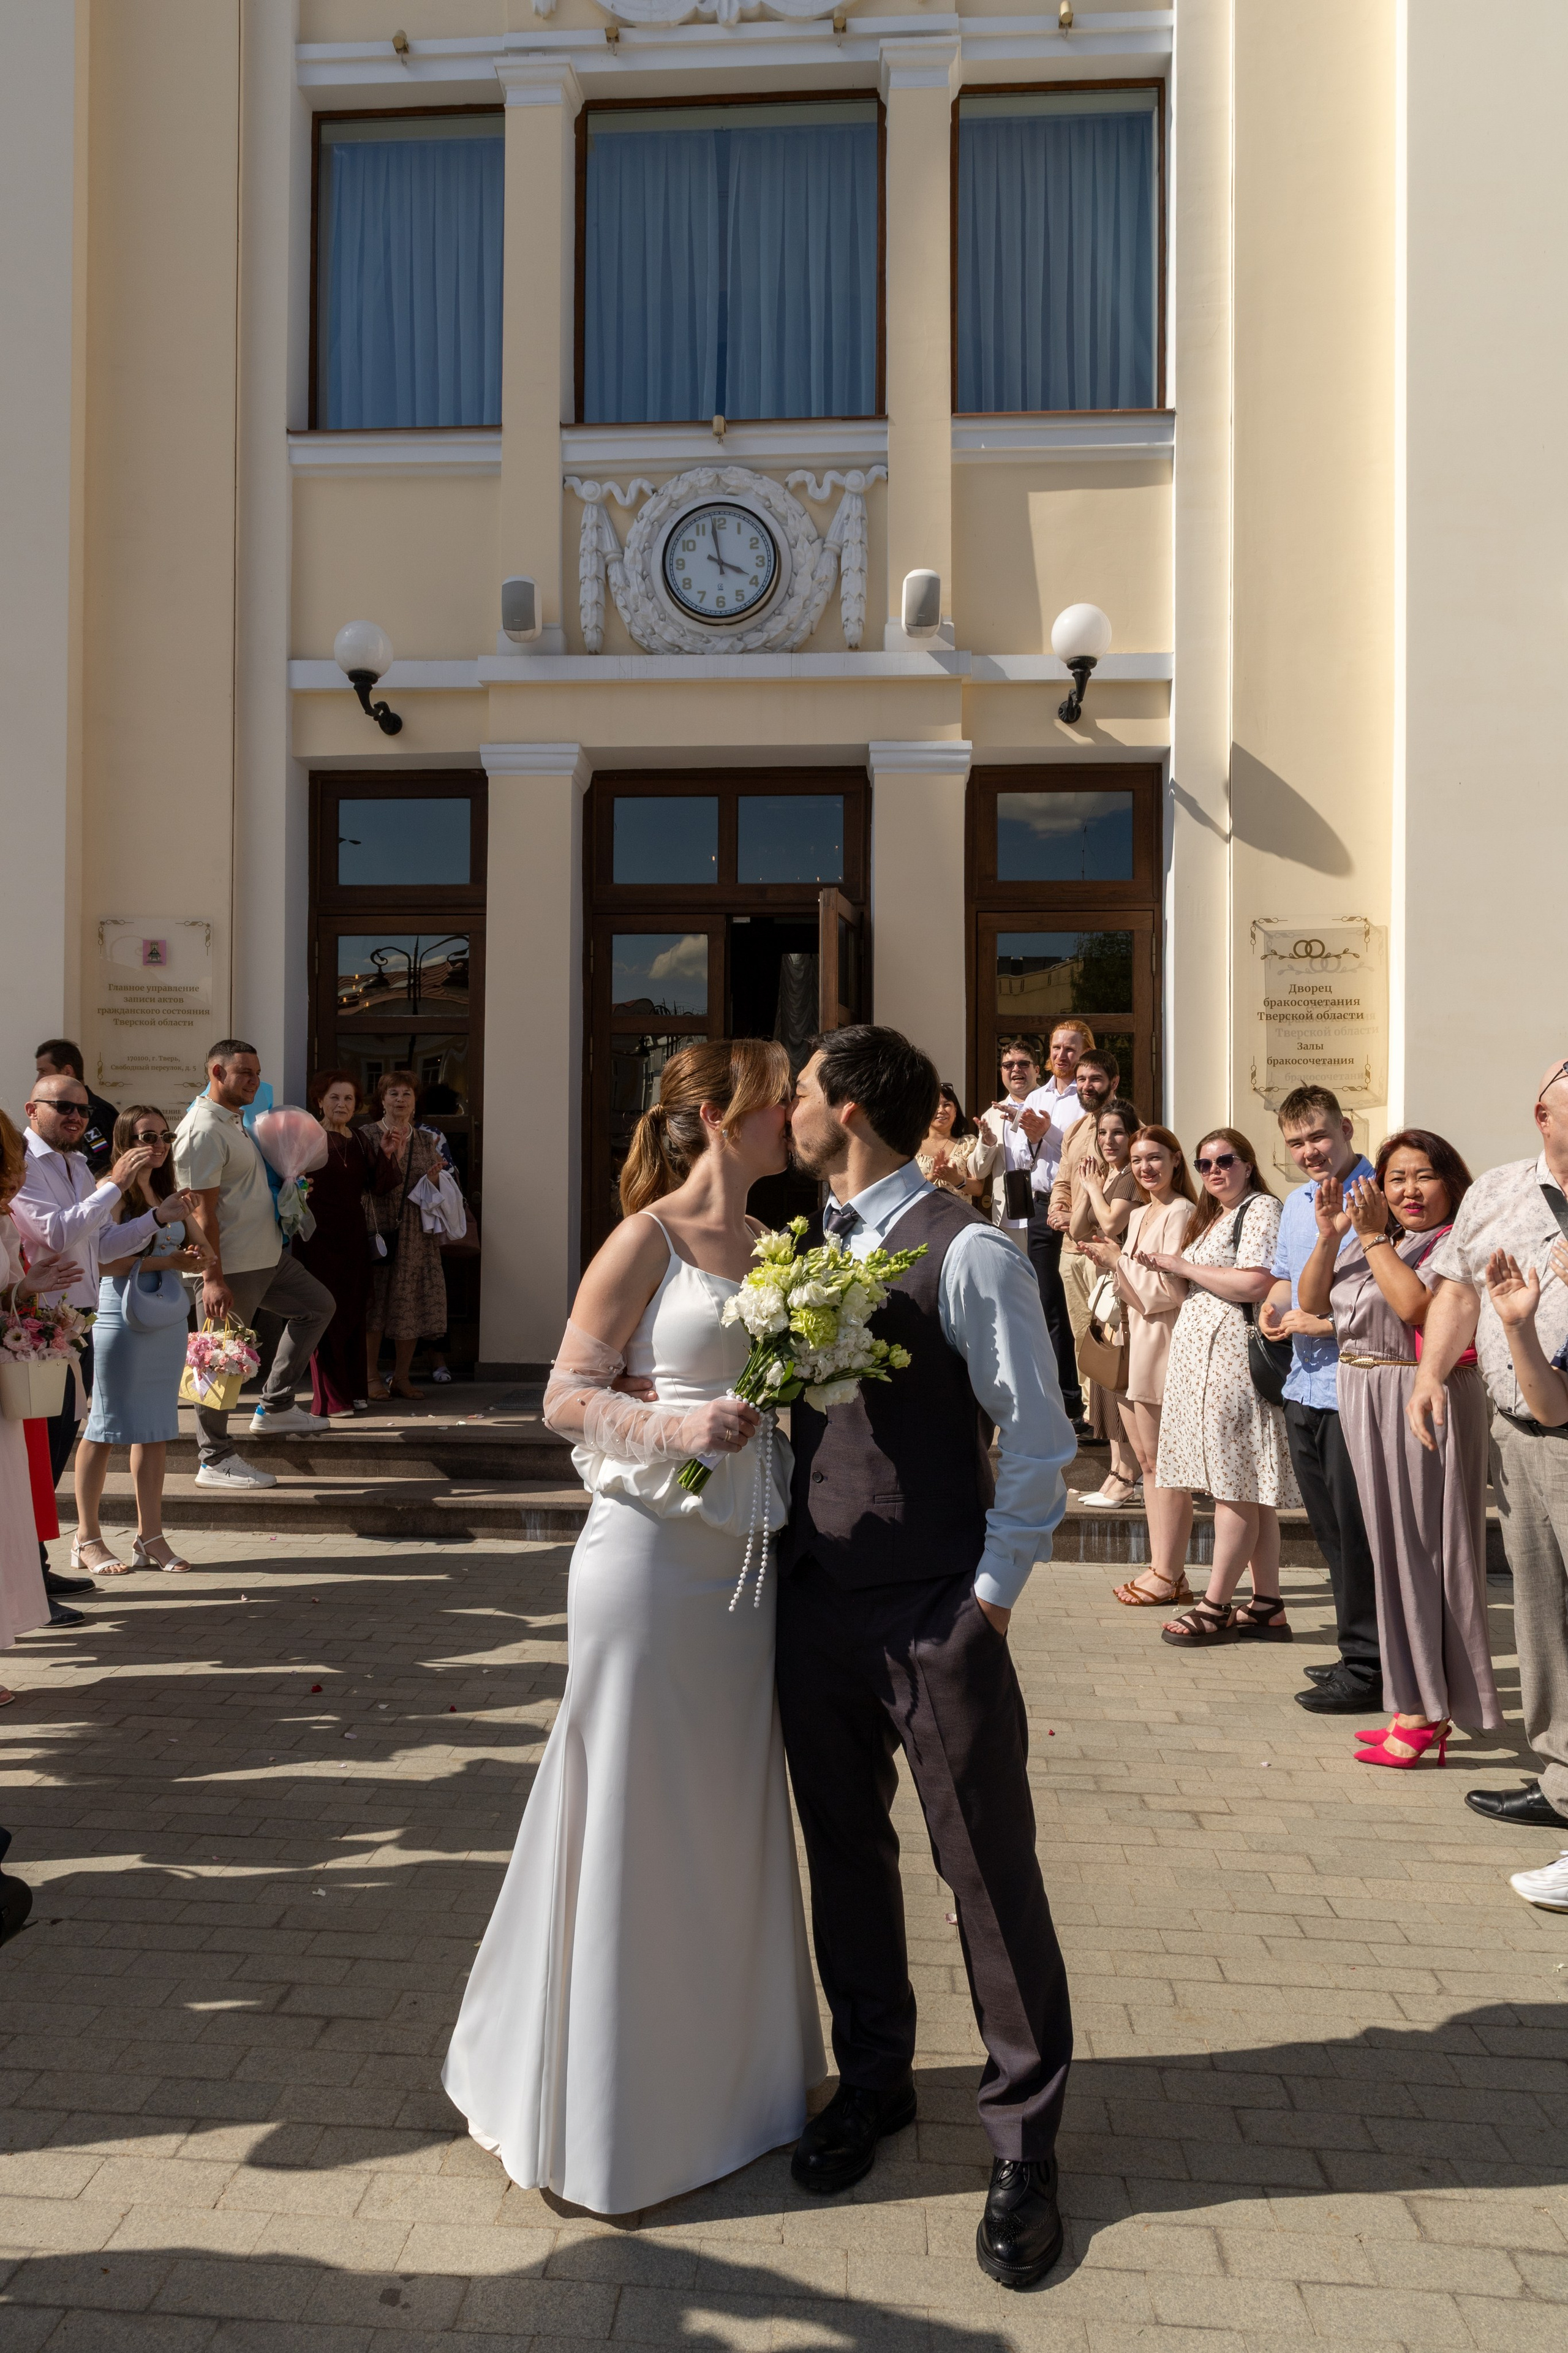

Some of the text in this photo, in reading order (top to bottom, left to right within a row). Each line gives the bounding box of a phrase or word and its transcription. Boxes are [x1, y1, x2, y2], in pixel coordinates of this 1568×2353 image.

[696, 524, 706, 536] 11
[713, 518, 726, 530] 12
[737, 522, 741, 535] 1
[682, 539, 696, 552] 10
[750, 537, 760, 550] 2
[676, 558, 685, 570] 9
[755, 555, 765, 567] 3
[682, 578, 692, 590] 8
[749, 575, 759, 587] 4
[697, 591, 706, 603] 7
[716, 595, 726, 608] 6
[735, 589, 745, 602] 5
[1289, 984, 1332, 995] Дворец
[1263, 997, 1360, 1009] бракосочетания
[97, 1007, 160, 1016] гражданского
[1257, 1011, 1313, 1023] Тверской
[1316, 1010, 1364, 1021] области
[113, 1018, 156, 1027] Тверской
[1297, 1042, 1324, 1051] Залы
[1267, 1056, 1355, 1067] бракосочетания
